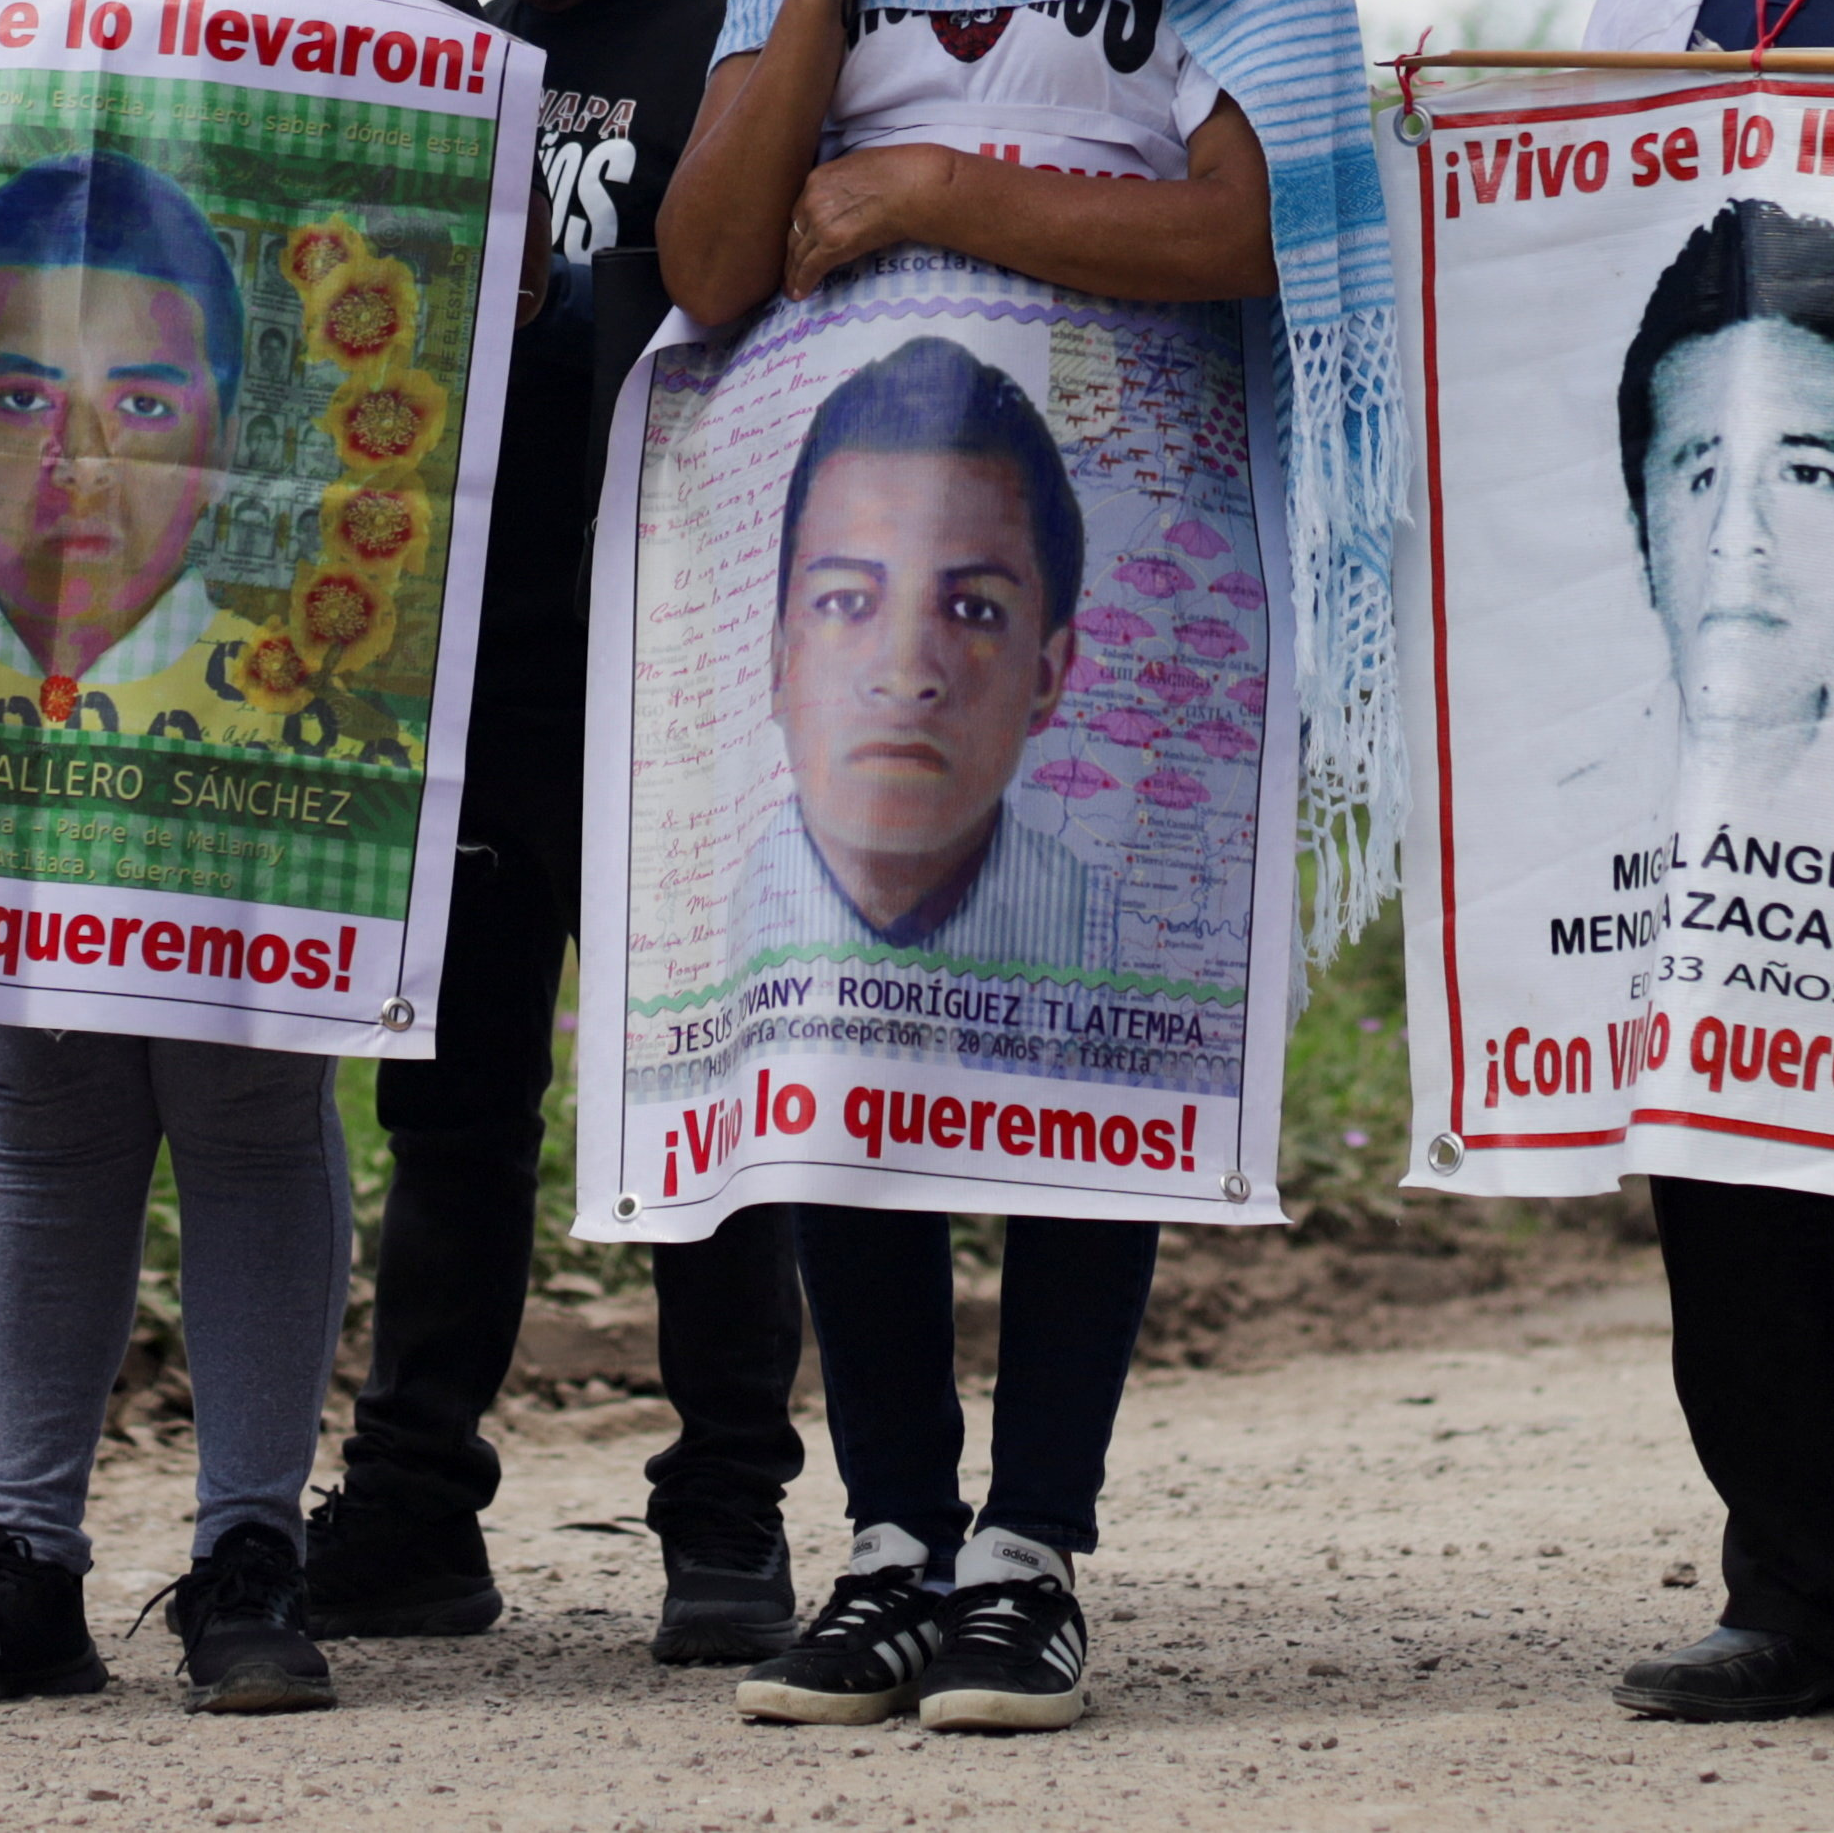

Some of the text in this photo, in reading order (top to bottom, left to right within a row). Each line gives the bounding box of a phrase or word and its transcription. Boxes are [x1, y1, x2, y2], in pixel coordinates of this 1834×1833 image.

[52, 89, 157, 122] Escocia,
[172, 102, 251, 128] quiero
[265, 112, 333, 140] saber
[344, 120, 414, 150] dónde
[426, 134, 481, 158] está
[1445, 132, 1610, 219] ¡Vivo
[1631, 125, 1700, 188] se
[1722, 107, 1775, 176] lo
[874, 251, 979, 276] Escocia,
[171, 766, 353, 827] SÁNCHEZ
[55, 816, 127, 843] Padre
[143, 826, 172, 849] de
[186, 829, 285, 867] Melanny
[115, 857, 236, 891] Guerrero
[1658, 955, 1705, 983] 33
[667, 1006, 733, 1056] JESÚS
[838, 976, 1022, 1030] RODRÍGUEZ
[1043, 998, 1205, 1047] TLATEMPA
[787, 1014, 923, 1047] Concepción
[956, 1032, 980, 1053] 20
[991, 1032, 1039, 1063] Años
[1484, 1026, 1593, 1110] ¡Con
[754, 1067, 817, 1137] lo
[843, 1085, 1200, 1174] queremos!
